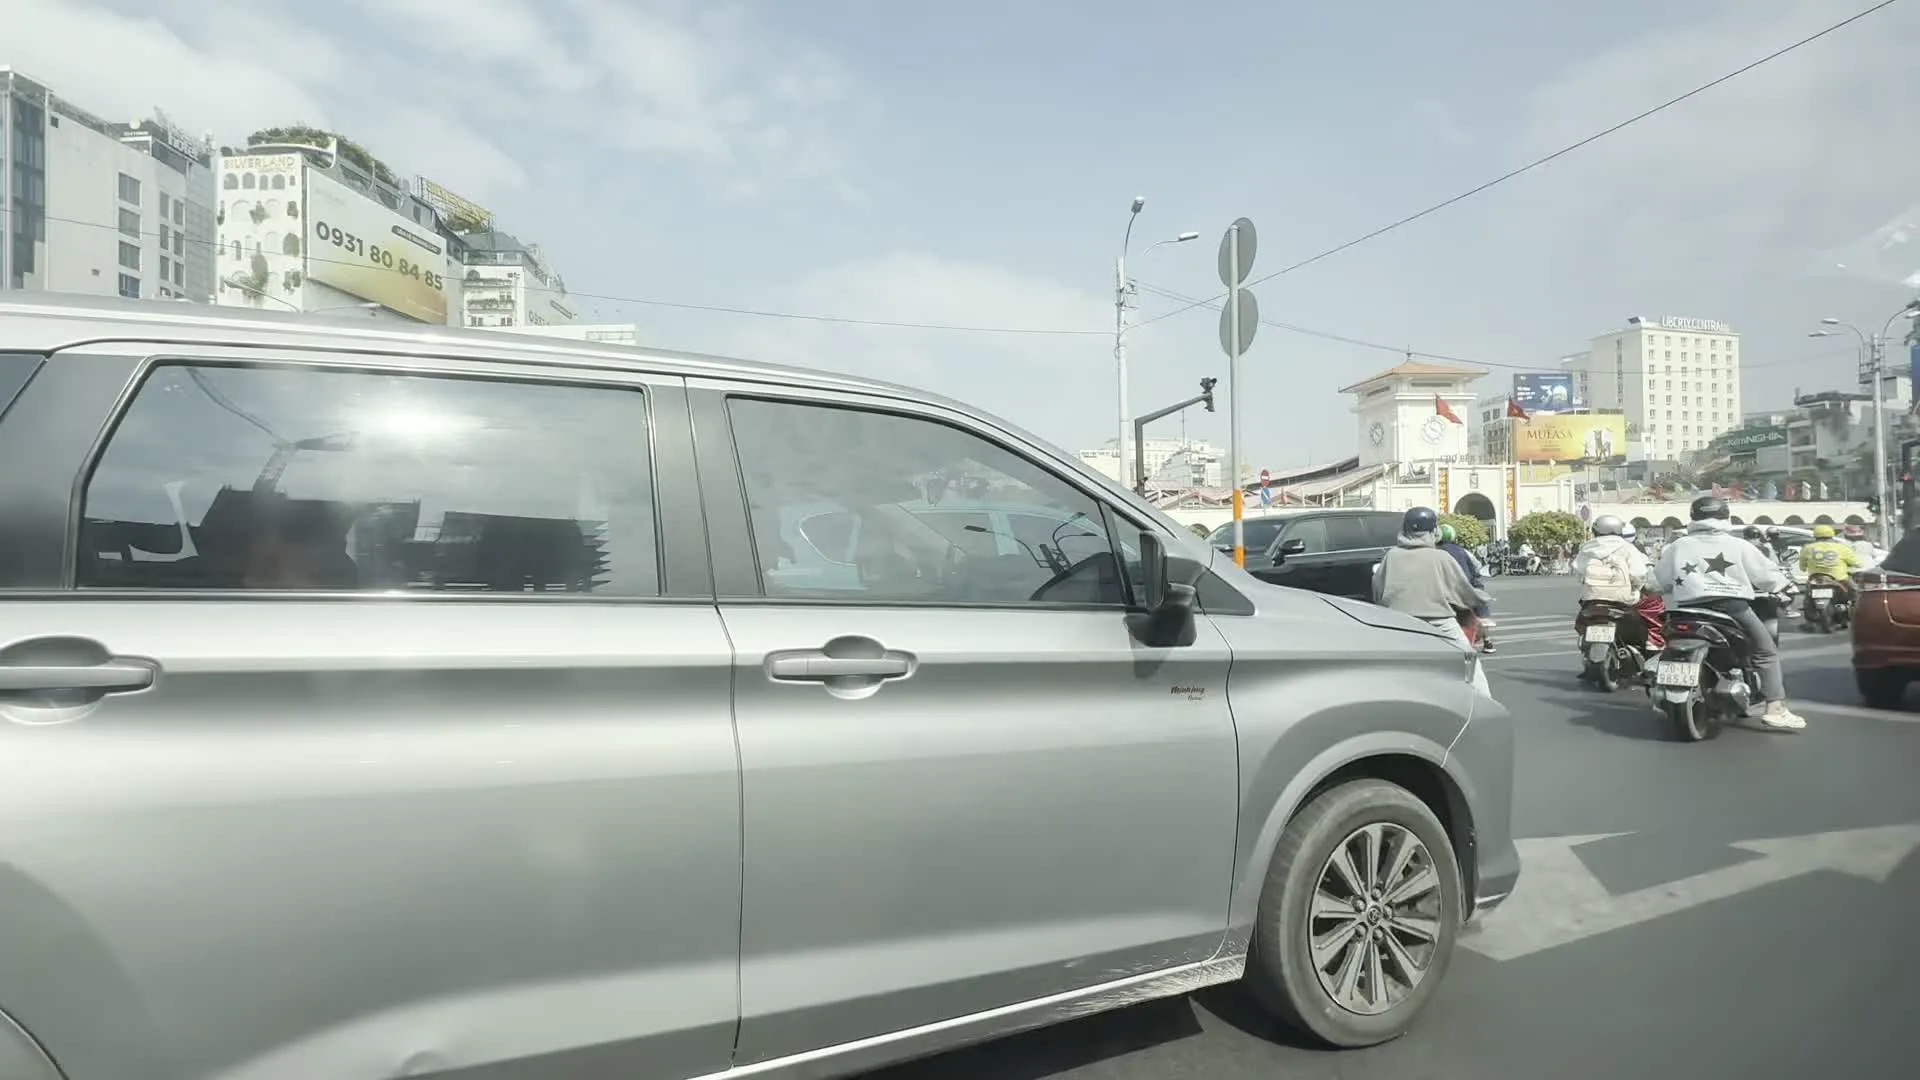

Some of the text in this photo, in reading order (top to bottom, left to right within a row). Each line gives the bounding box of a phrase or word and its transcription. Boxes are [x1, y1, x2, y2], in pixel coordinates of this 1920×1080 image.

[223, 156, 295, 170] SILVERLAND
[316, 221, 442, 291] 0931 80 84 85
